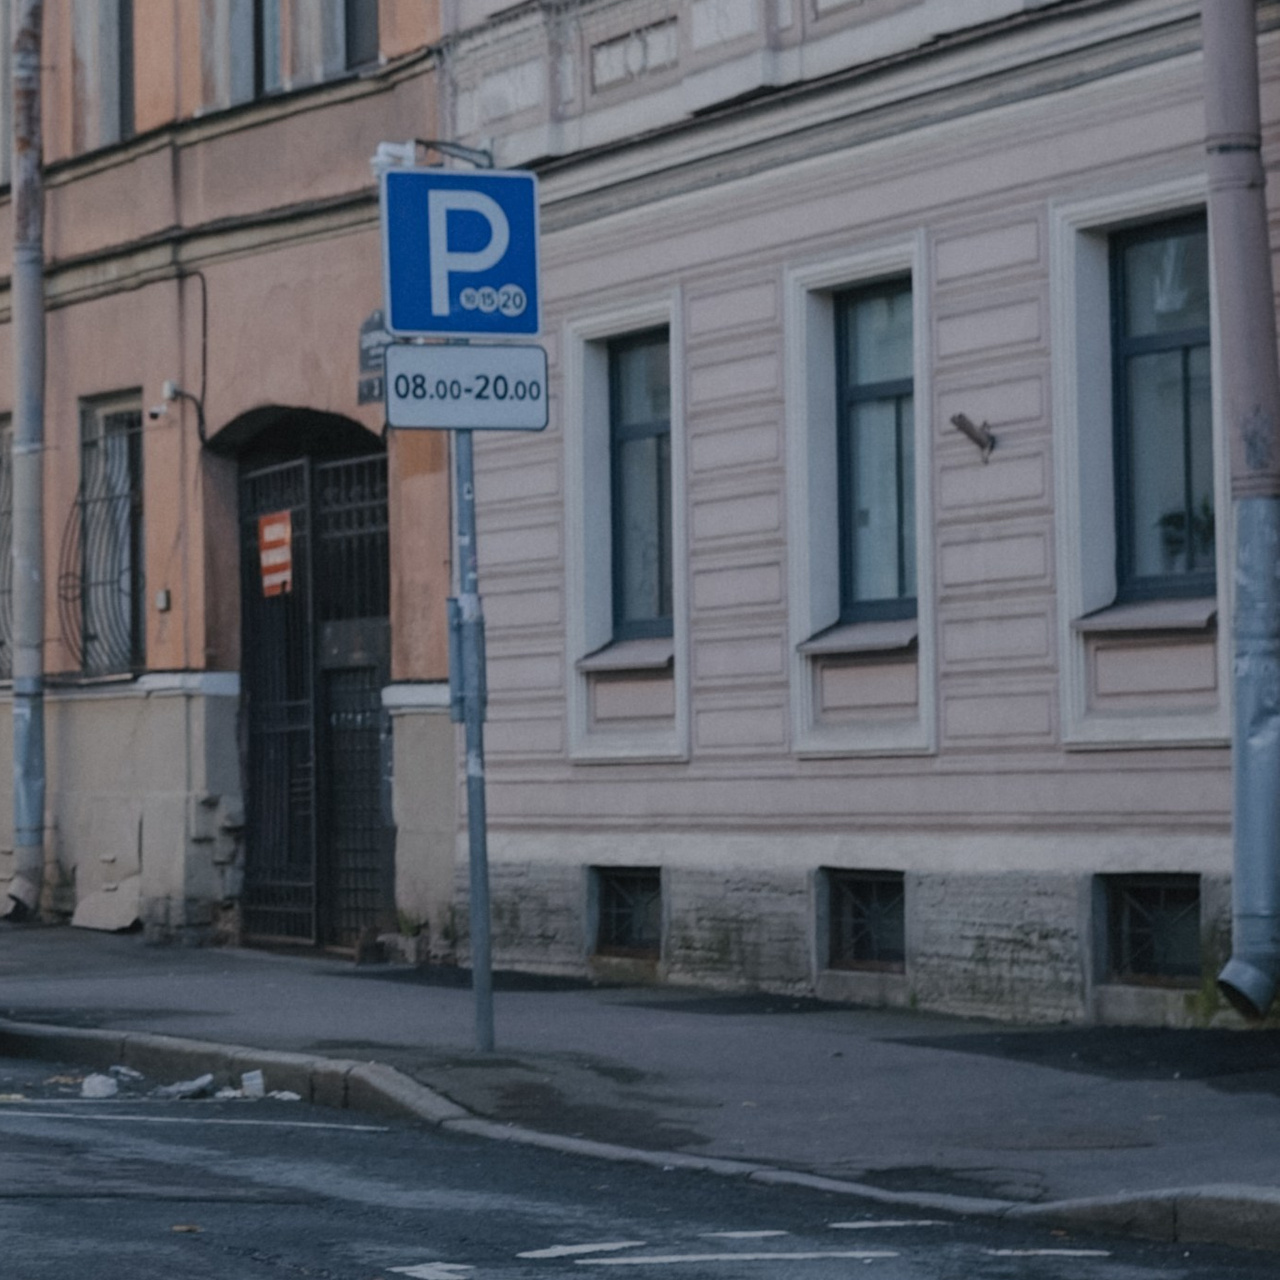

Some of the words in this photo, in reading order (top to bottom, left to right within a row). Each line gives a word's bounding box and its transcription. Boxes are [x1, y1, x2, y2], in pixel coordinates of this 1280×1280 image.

[427, 188, 510, 317] P
[481, 291, 495, 307] 15
[501, 290, 524, 311] 20
[394, 373, 541, 401] 08.00-20.00
